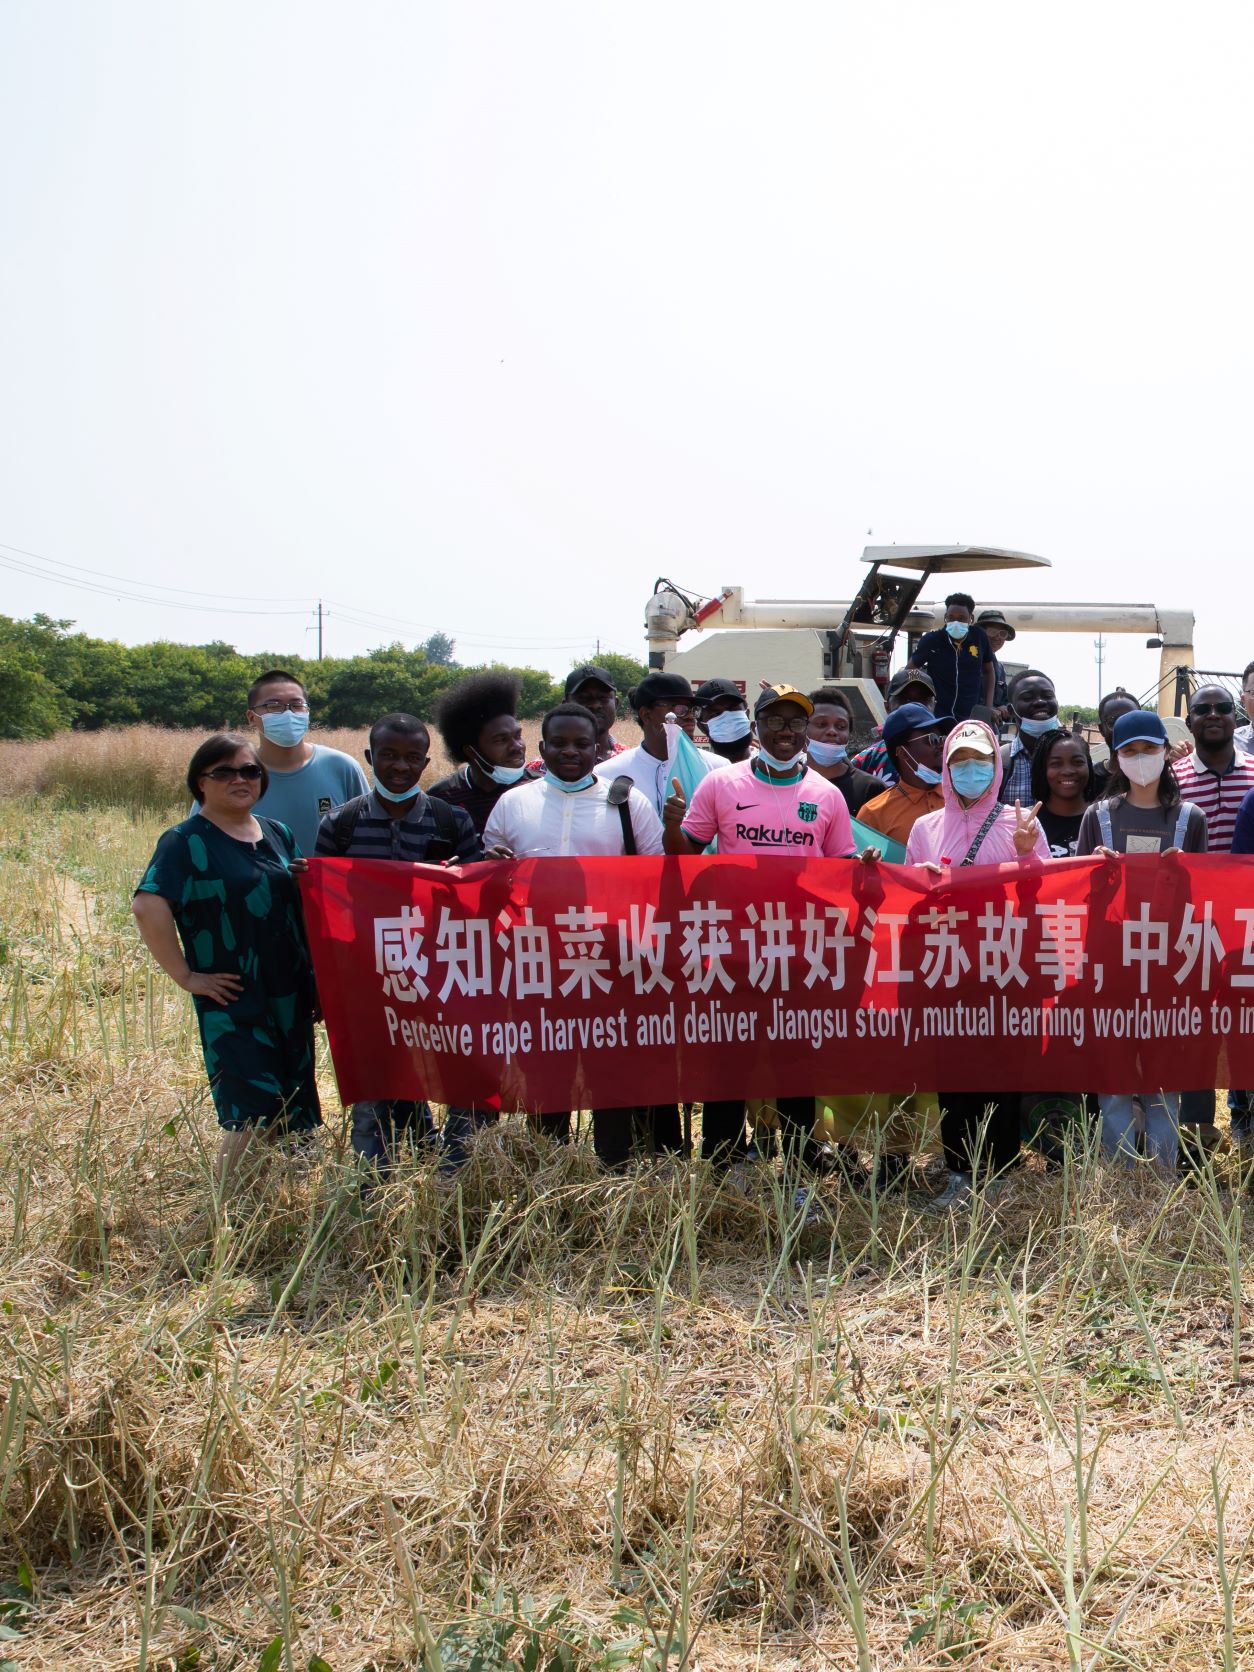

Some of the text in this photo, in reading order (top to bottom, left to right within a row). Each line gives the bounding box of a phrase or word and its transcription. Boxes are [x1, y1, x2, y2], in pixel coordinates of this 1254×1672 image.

[955, 730, 977, 740] FILA
[736, 824, 814, 846] Rakuten
[383, 1007, 473, 1056] Perceive
[482, 1020, 532, 1064] rape
[540, 1007, 628, 1052] harvest
[637, 1002, 676, 1046] and
[684, 1000, 758, 1044] deliver
[766, 998, 848, 1049] Jiangsu
[1002, 995, 1085, 1047] learning
[1092, 995, 1202, 1040] worldwide
[1210, 1000, 1232, 1035] to
